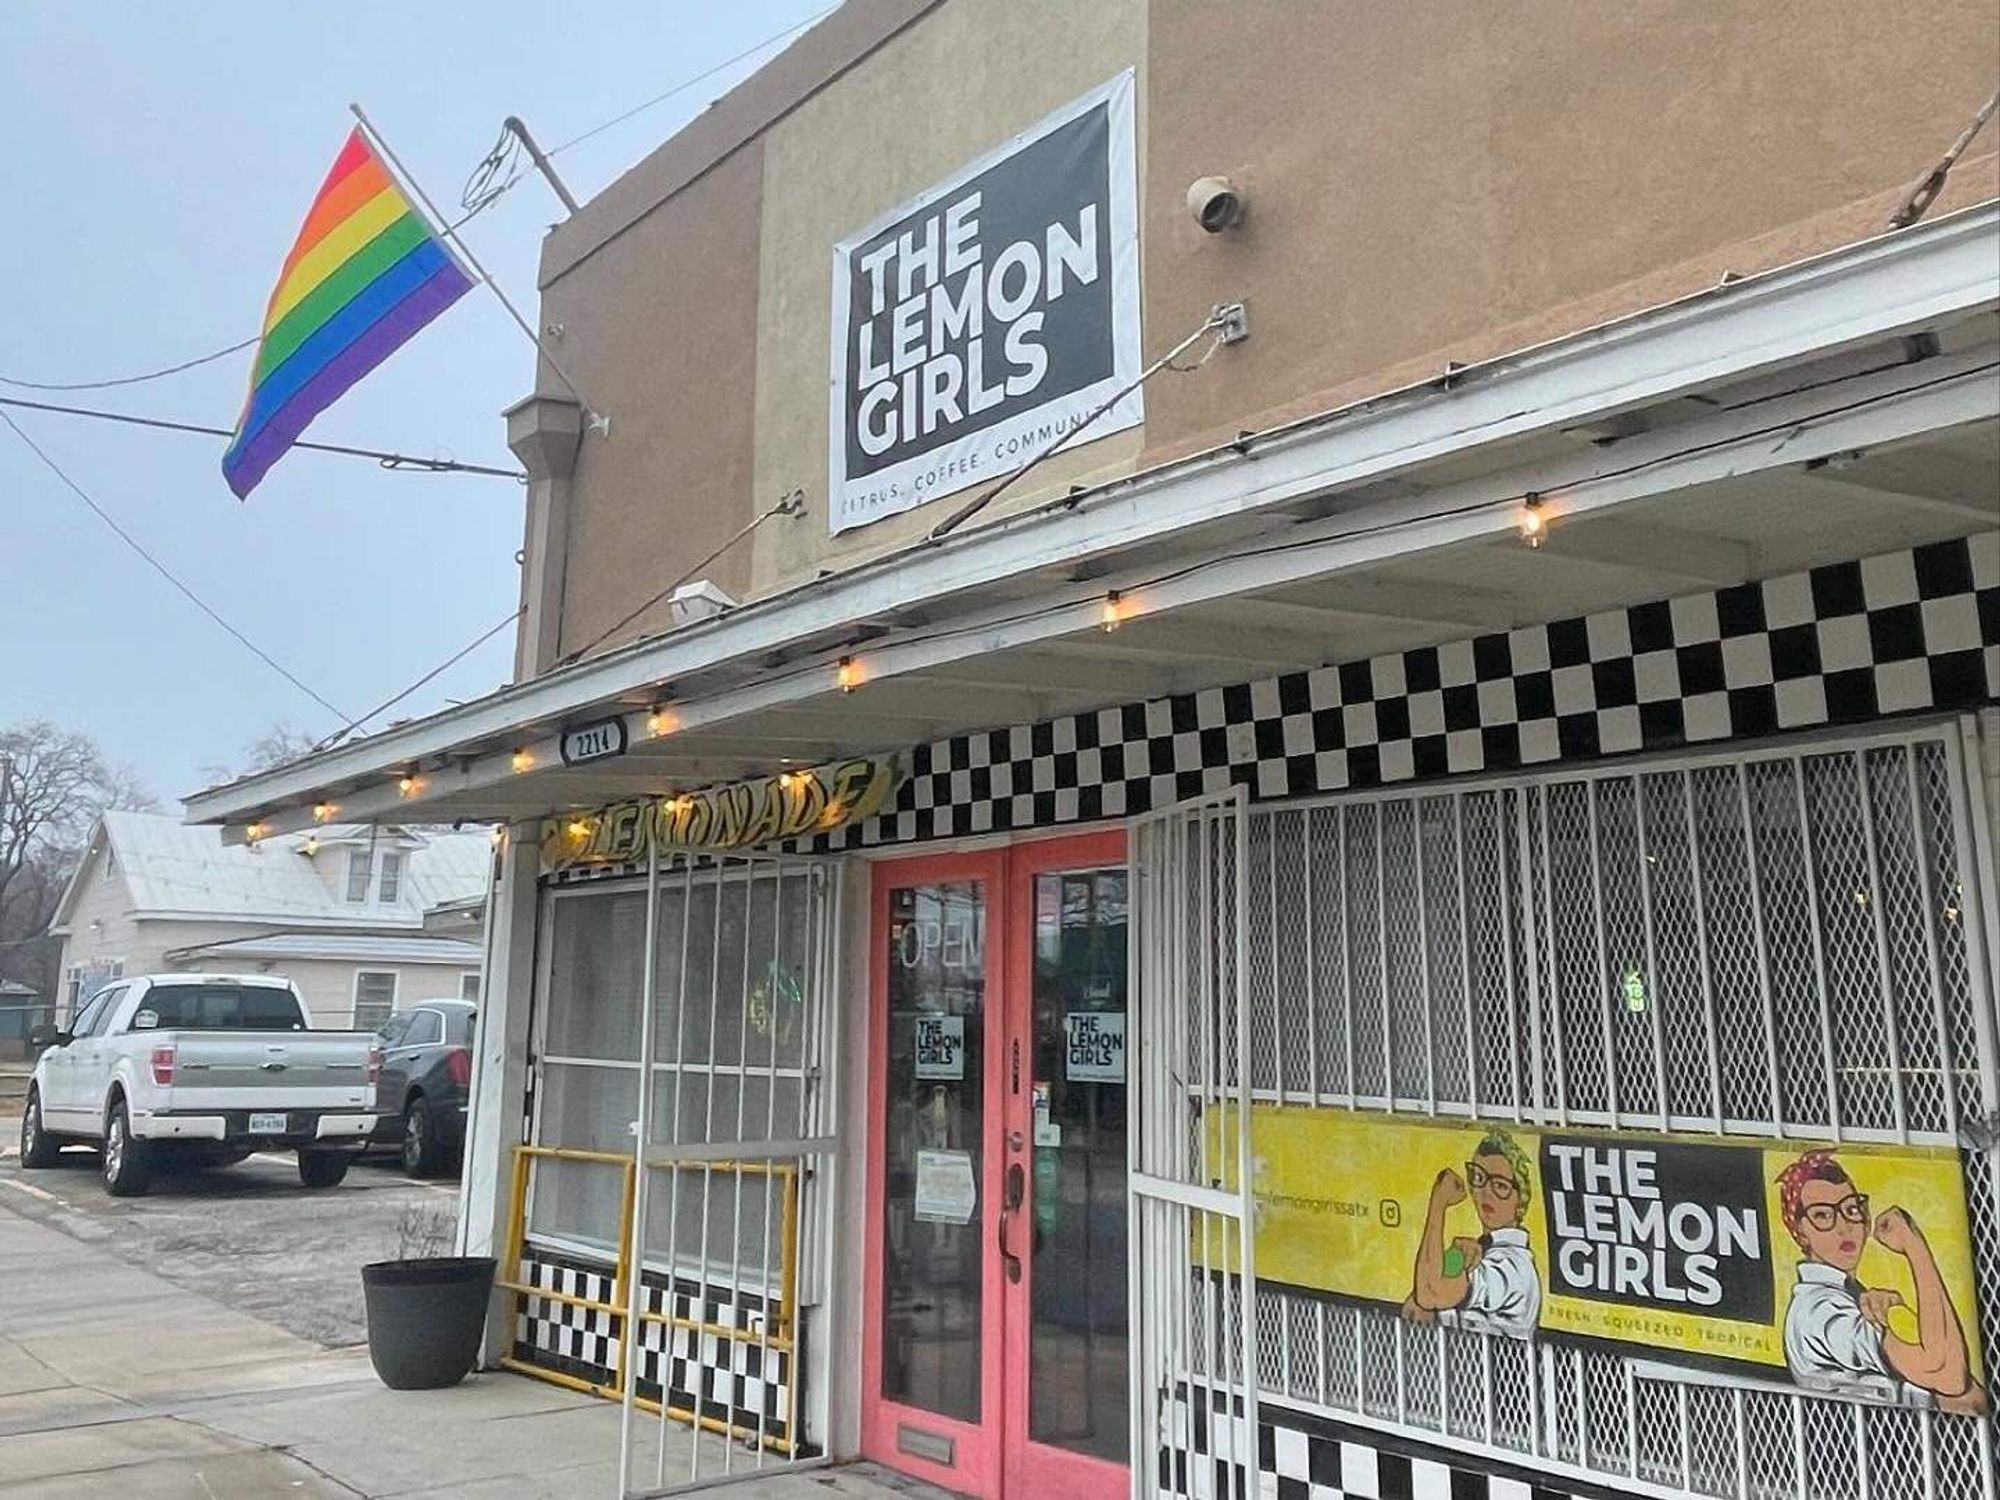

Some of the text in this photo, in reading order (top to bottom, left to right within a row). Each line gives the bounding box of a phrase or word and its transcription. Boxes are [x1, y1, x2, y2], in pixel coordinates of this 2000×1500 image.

[860, 191, 982, 316] THE
[858, 203, 1099, 390] LEMON
[857, 312, 1048, 457] GIRLS
[577, 727, 609, 757] 2214
[901, 919, 982, 969] OPEN
[918, 1034, 962, 1049] LEMON
[919, 1020, 942, 1034] THE
[1070, 1016, 1099, 1032] THE
[1070, 1033, 1122, 1050] LEMON
[919, 1049, 953, 1064] GIRLS
[1070, 1049, 1113, 1067] GIRLS
[1550, 1144, 1661, 1200] THE
[1552, 1191, 1761, 1260] LEMON
[1559, 1239, 1723, 1306] GIRLS
[1603, 1315, 1684, 1338] SQUEEZED
[1697, 1329, 1772, 1352] TROPICAL
